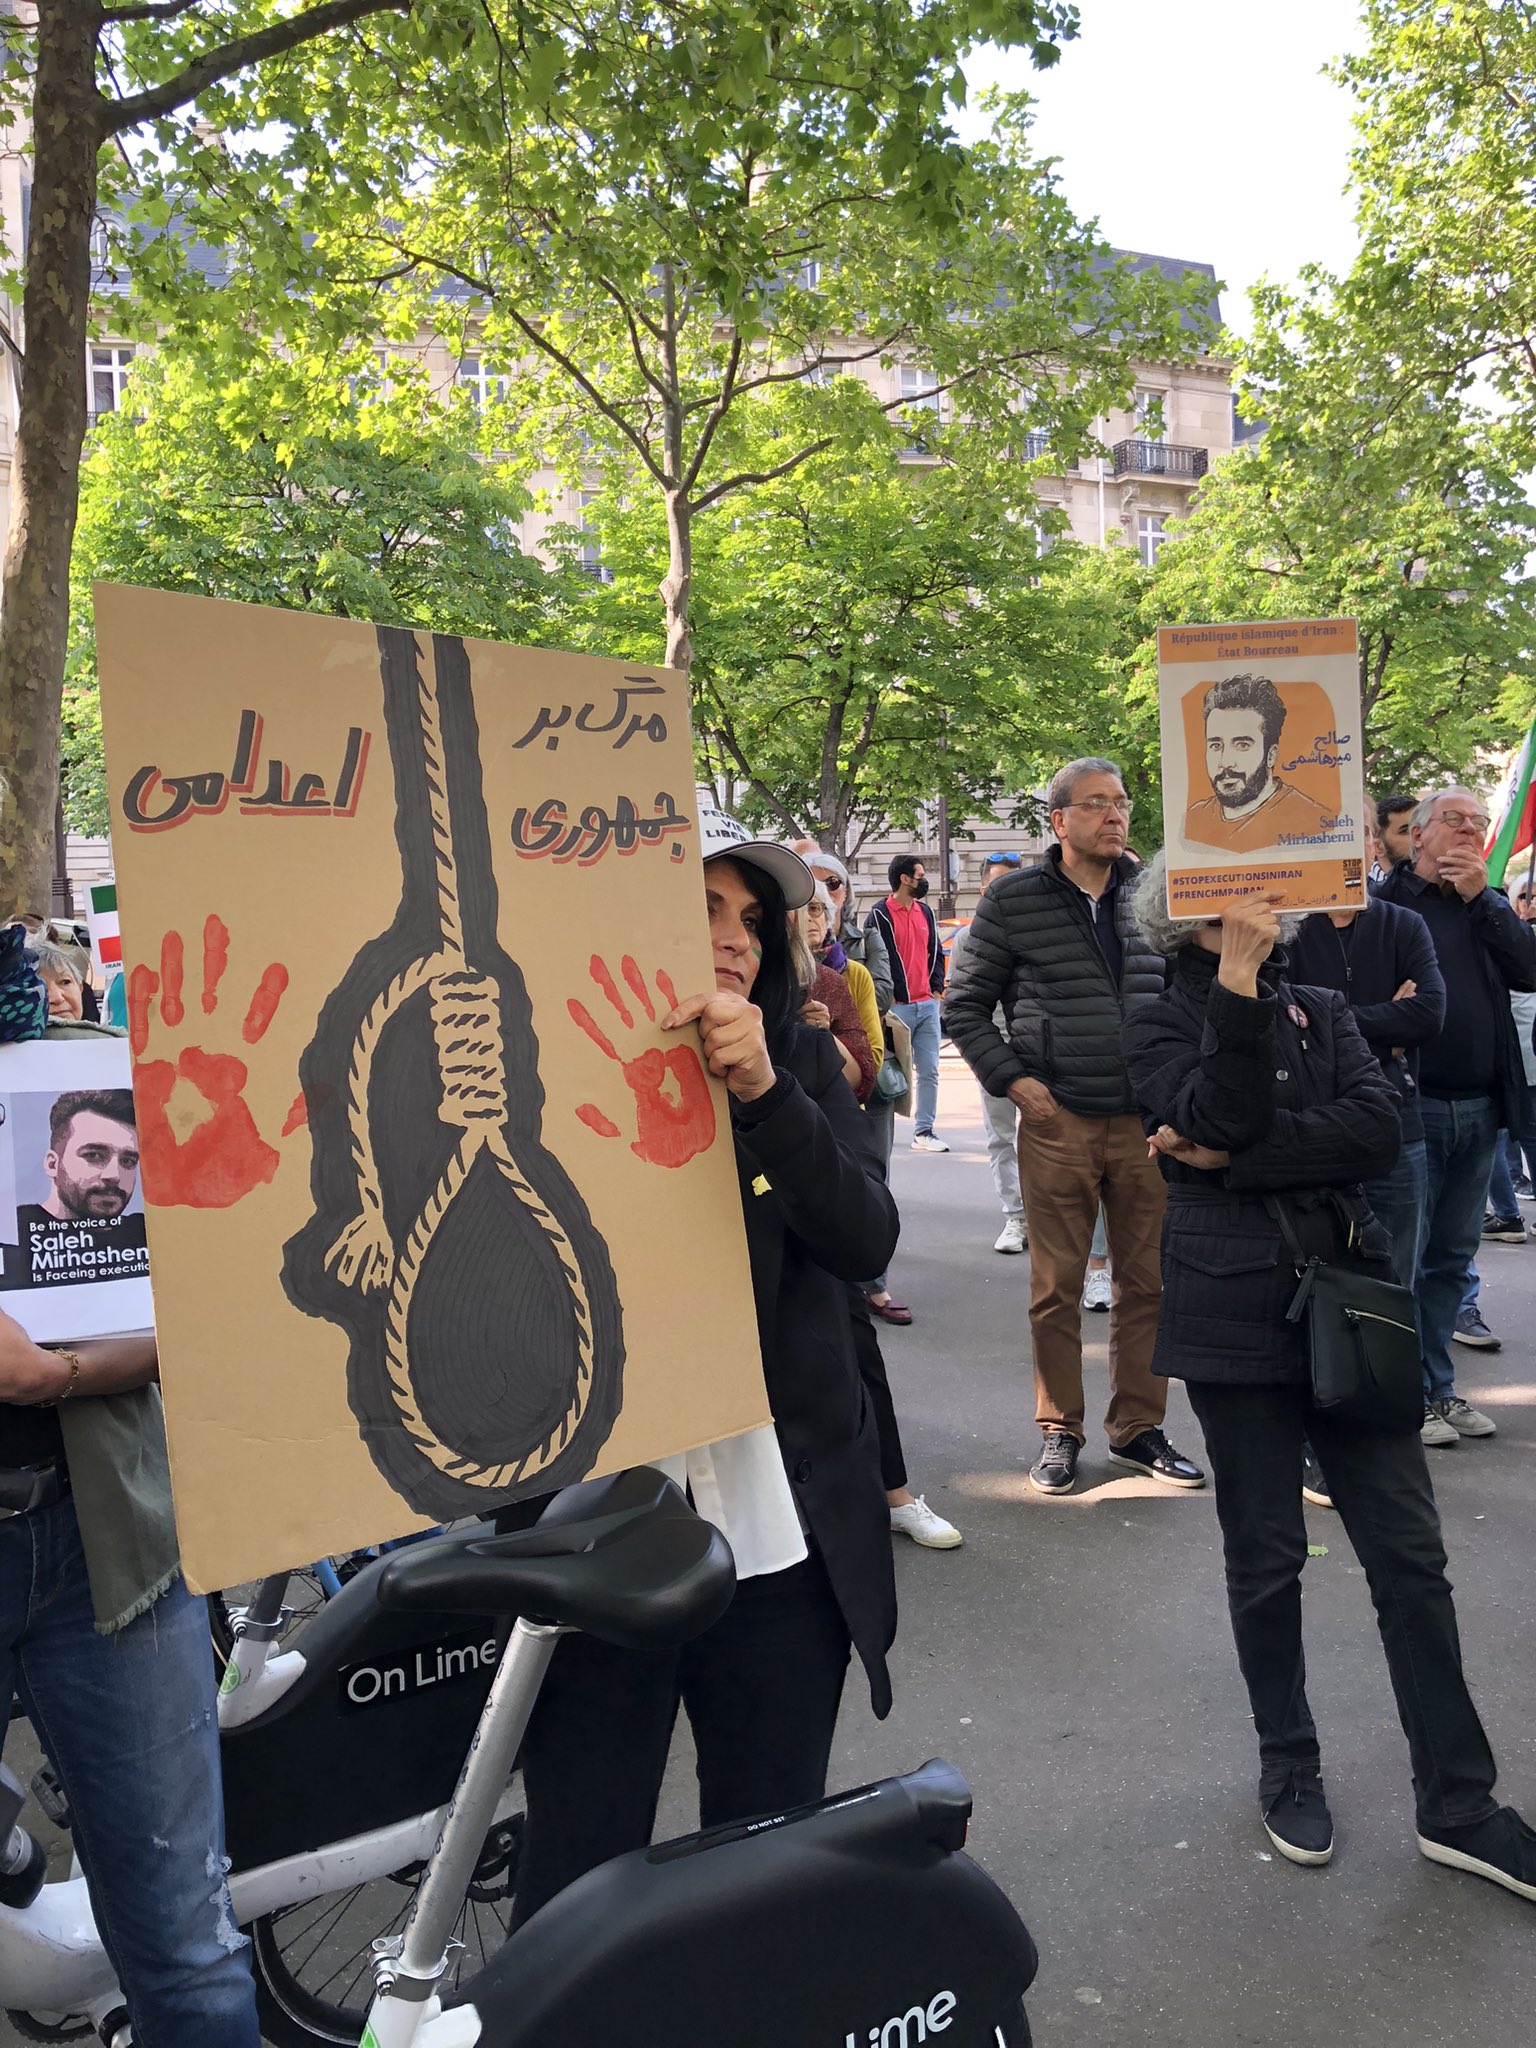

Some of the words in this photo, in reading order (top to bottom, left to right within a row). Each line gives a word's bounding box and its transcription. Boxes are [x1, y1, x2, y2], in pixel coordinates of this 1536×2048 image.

[1171, 631, 1239, 644] République
[1241, 627, 1298, 641] islamique
[1217, 646, 1240, 657] État
[1244, 645, 1299, 657] Bourreau
[575, 676, 667, 749] مرگ
[512, 705, 572, 751] بر
[1313, 731, 1351, 752] صالح
[1320, 814, 1354, 828] Saleh
[705, 829, 749, 842] LIBER
[1278, 831, 1354, 846] Mirhashemi
[1343, 859, 1361, 867] STOP
[1173, 870, 1303, 885] #STOPEXECUTIONSINIRAN
[29, 1222, 45, 1232] Be
[48, 1221, 69, 1231] the
[72, 1217, 106, 1229] voice
[110, 1216, 122, 1226] of
[30, 1231, 94, 1252] Saleh
[32, 1272, 43, 1282] Is
[46, 1268, 96, 1281] Faceing
[347, 1667, 405, 1703] On
[415, 1639, 496, 1687] Lime
[758, 1819, 773, 1828] NOT
[773, 1816, 785, 1824] SIT
